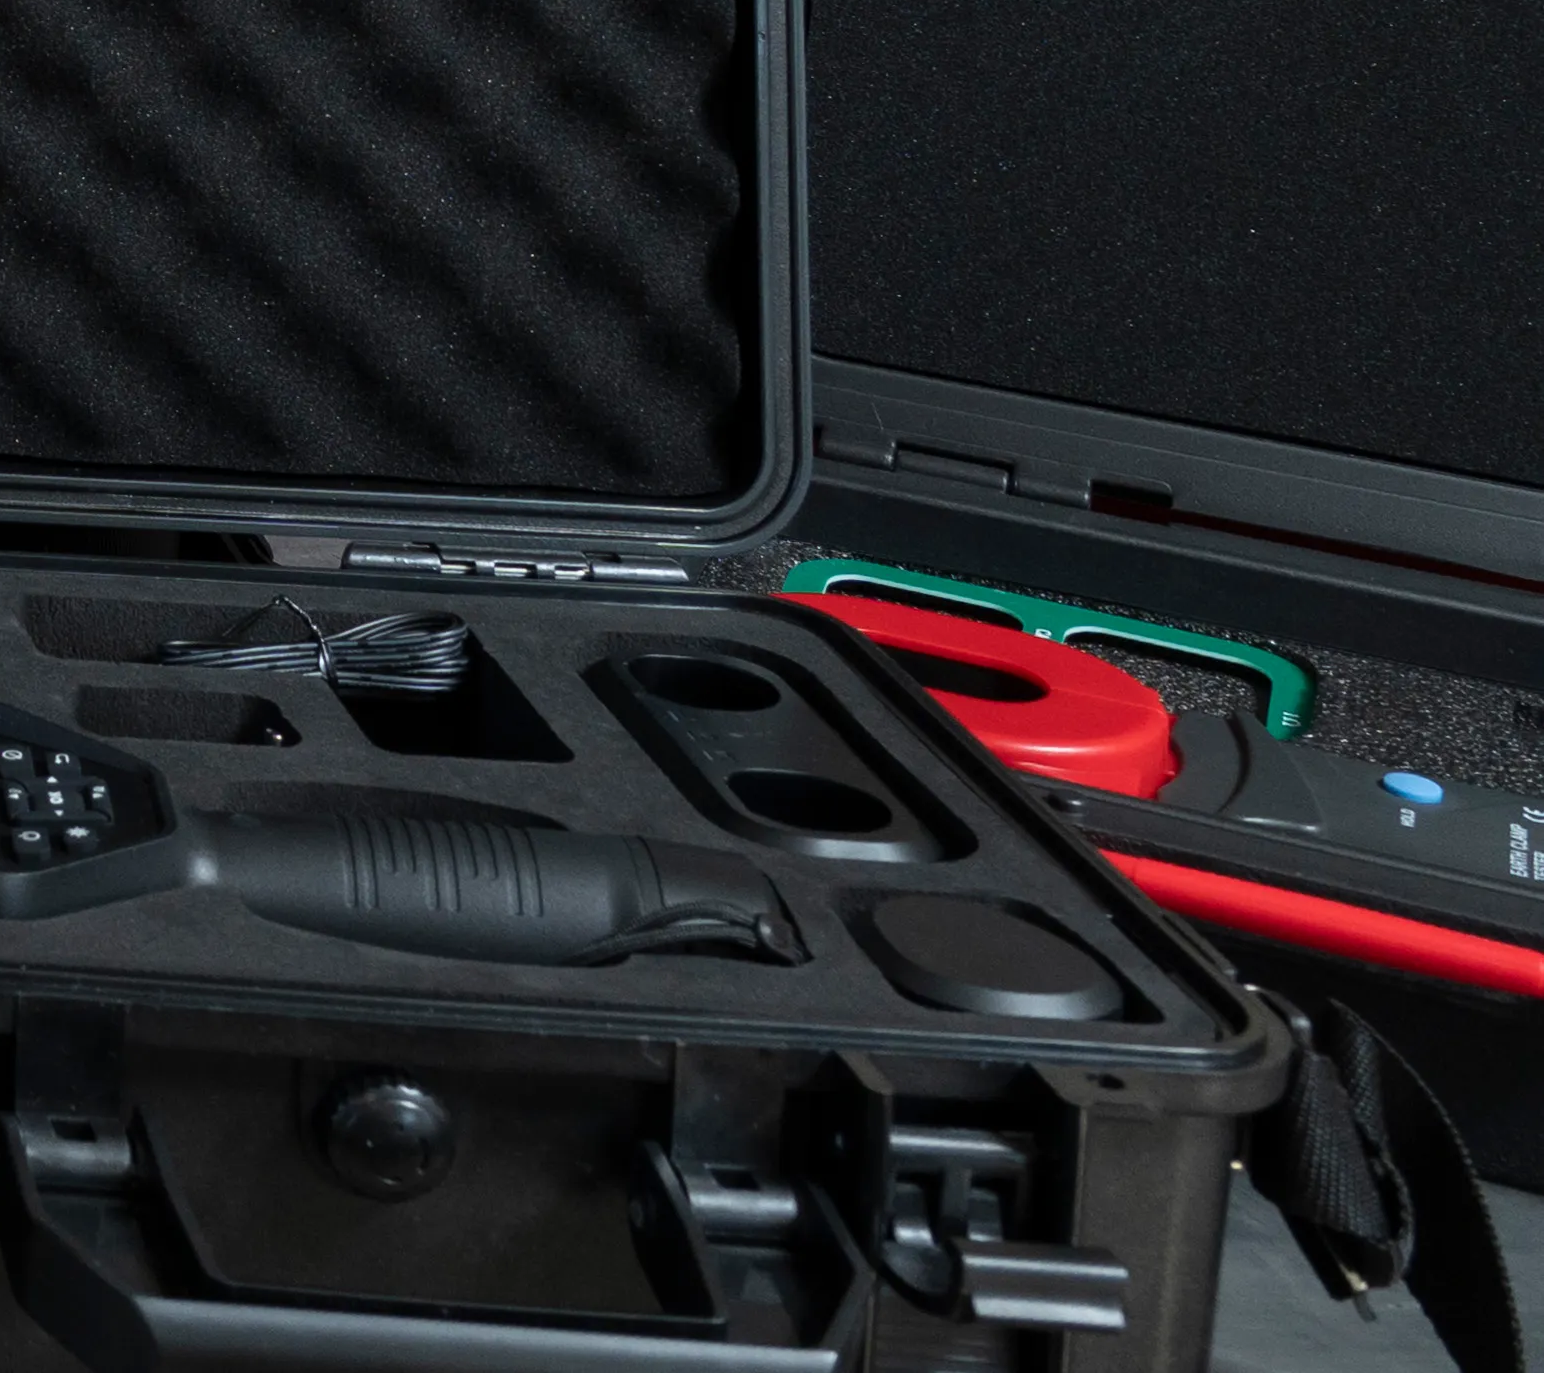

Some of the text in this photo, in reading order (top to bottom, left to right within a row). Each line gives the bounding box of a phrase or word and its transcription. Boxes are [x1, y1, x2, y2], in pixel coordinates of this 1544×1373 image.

[1400, 807, 1416, 828] HOLD
[1510, 822, 1530, 879] EARTH CLAMP
